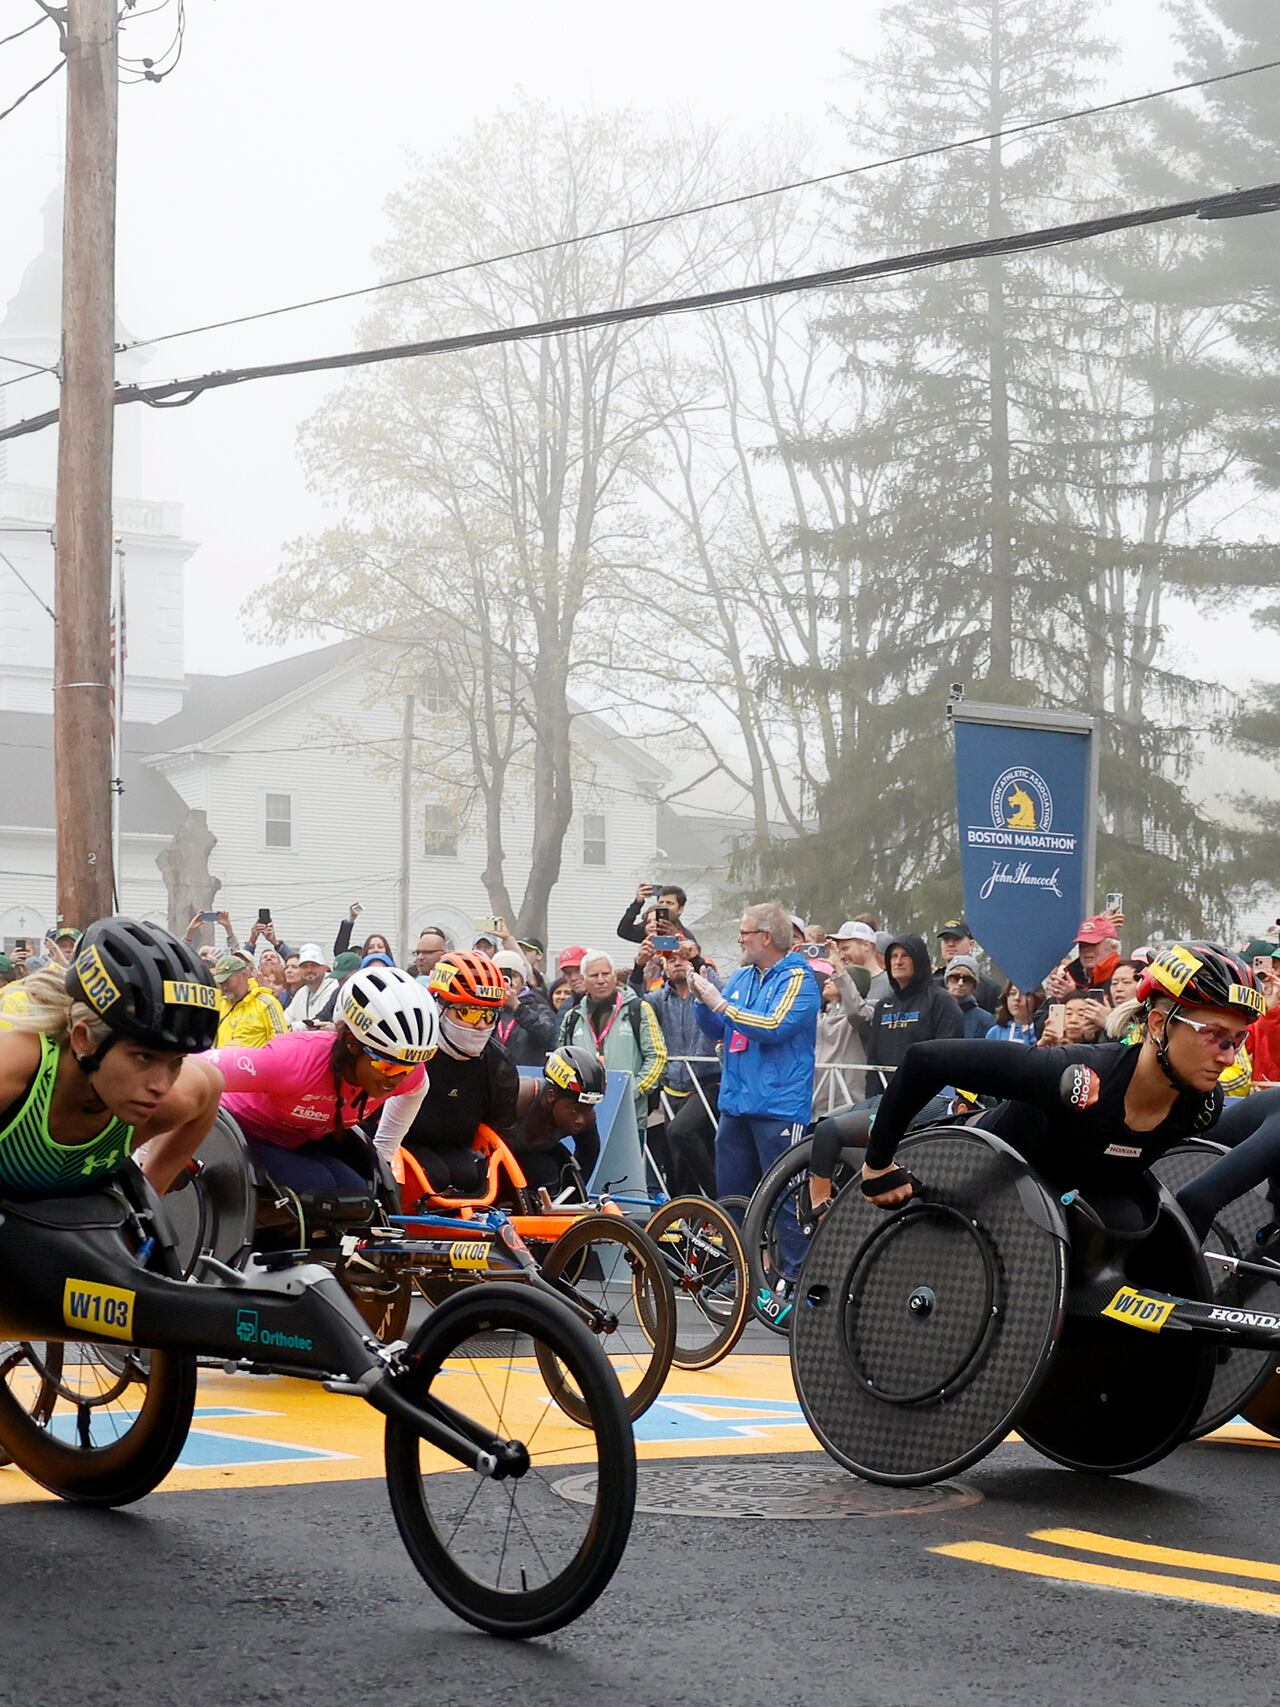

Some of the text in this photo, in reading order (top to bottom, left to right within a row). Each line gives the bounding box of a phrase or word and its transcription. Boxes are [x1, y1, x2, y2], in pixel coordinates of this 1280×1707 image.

[994, 770, 1050, 829] BOSTON ATHLETIC ASSOCIATION
[968, 830, 1074, 850] BOSTON MARATHON
[980, 860, 1063, 899] John Hancock
[79, 950, 116, 1010] W103
[1156, 951, 1193, 984] W101
[174, 983, 216, 1007] W103
[1237, 986, 1265, 1012] W101
[343, 997, 373, 1031] W106
[1070, 1069, 1083, 1104] 2000
[1079, 1066, 1091, 1109] SPORT
[453, 1243, 485, 1260] W106
[70, 1291, 128, 1328] W103
[1114, 1293, 1165, 1322] W101
[260, 1330, 313, 1351] Orthotec
